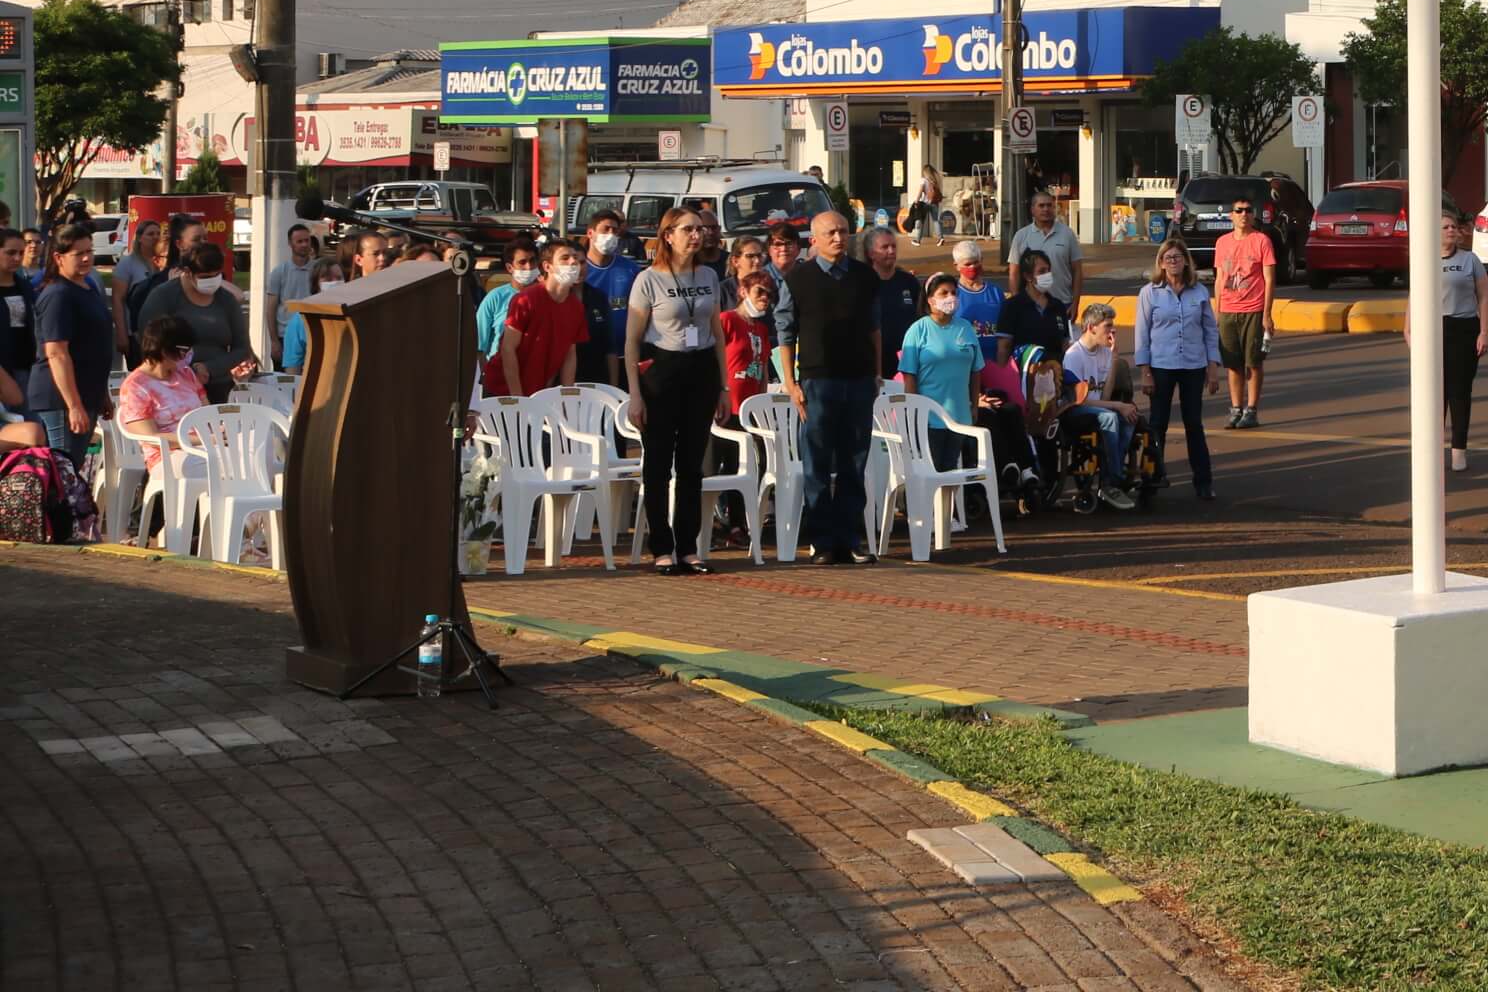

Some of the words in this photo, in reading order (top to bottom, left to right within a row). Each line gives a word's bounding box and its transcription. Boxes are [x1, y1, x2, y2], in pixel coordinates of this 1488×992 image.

[791, 33, 807, 48] lojas
[971, 25, 989, 42] lojas
[777, 39, 883, 77] Colombo
[618, 62, 680, 77] FARMÁCIA
[447, 67, 506, 94] FARMÁCIA
[528, 66, 566, 92] CRUZ
[565, 66, 606, 91] AZUL
[617, 79, 659, 94] CRUZ
[661, 79, 702, 94] AZUL
[1190, 101, 1197, 111] E
[834, 111, 841, 125] E
[1019, 116, 1027, 130] E
[667, 286, 713, 298] SMECE
